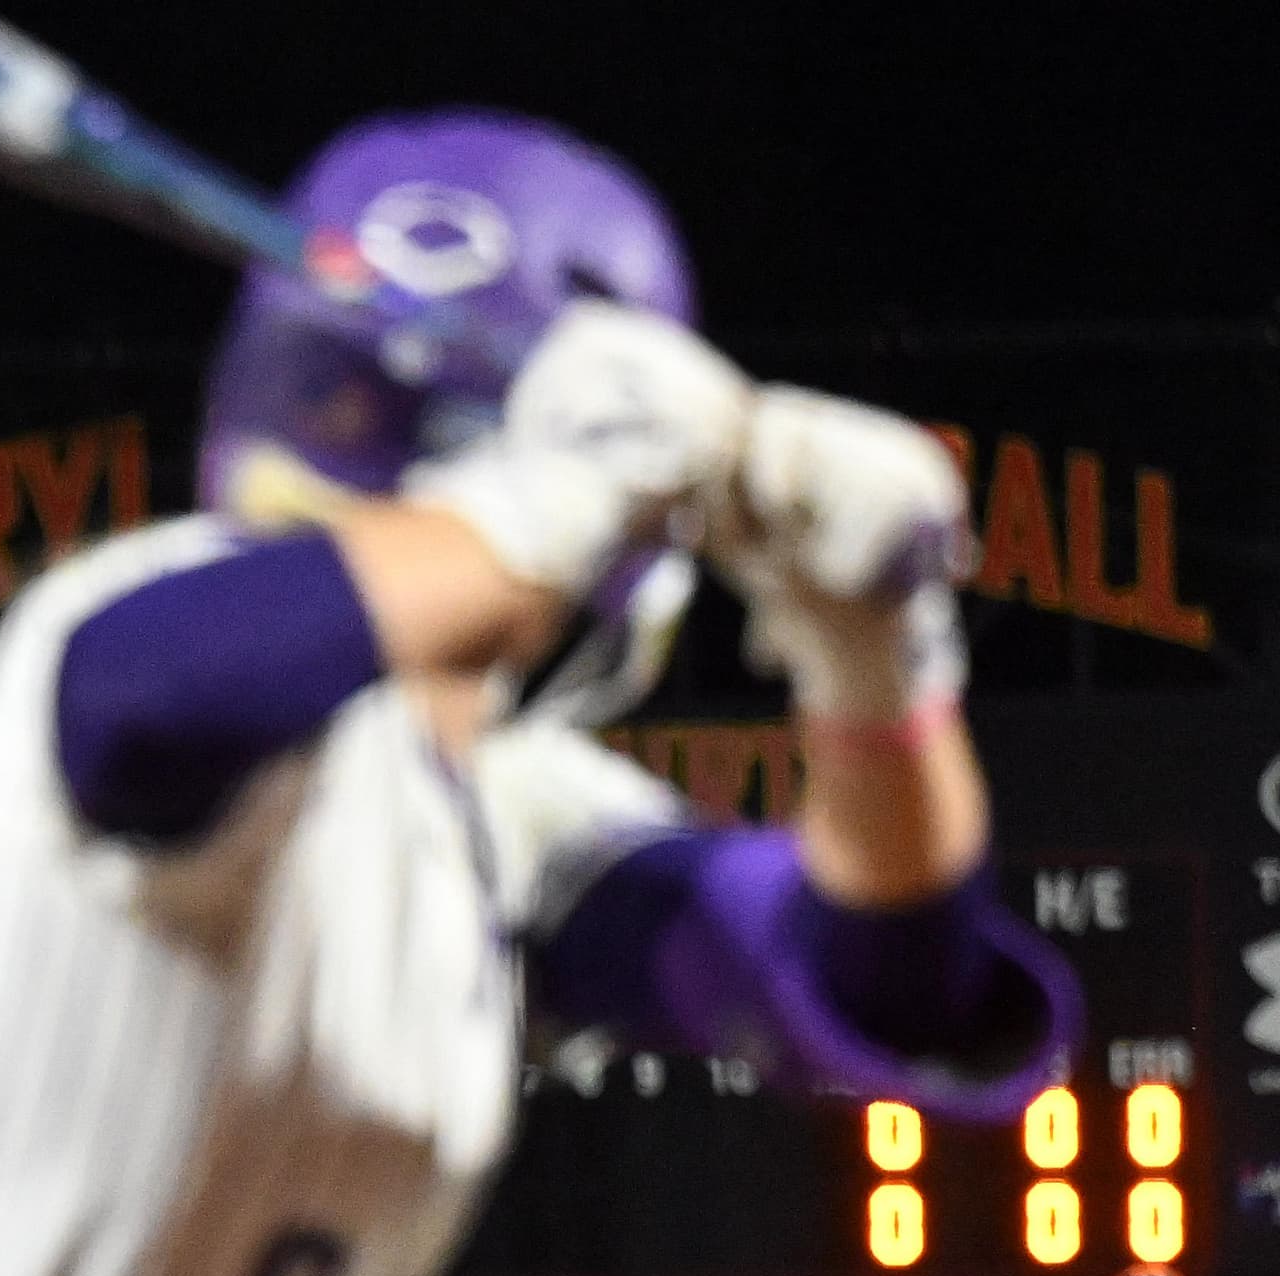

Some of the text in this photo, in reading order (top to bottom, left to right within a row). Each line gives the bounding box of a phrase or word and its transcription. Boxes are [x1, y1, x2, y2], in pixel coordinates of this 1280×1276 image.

[920, 424, 1214, 650] ALL
[1024, 1086, 1080, 1169] 0
[1126, 1082, 1182, 1168] 0
[868, 1179, 1185, 1268] 0 0 0
